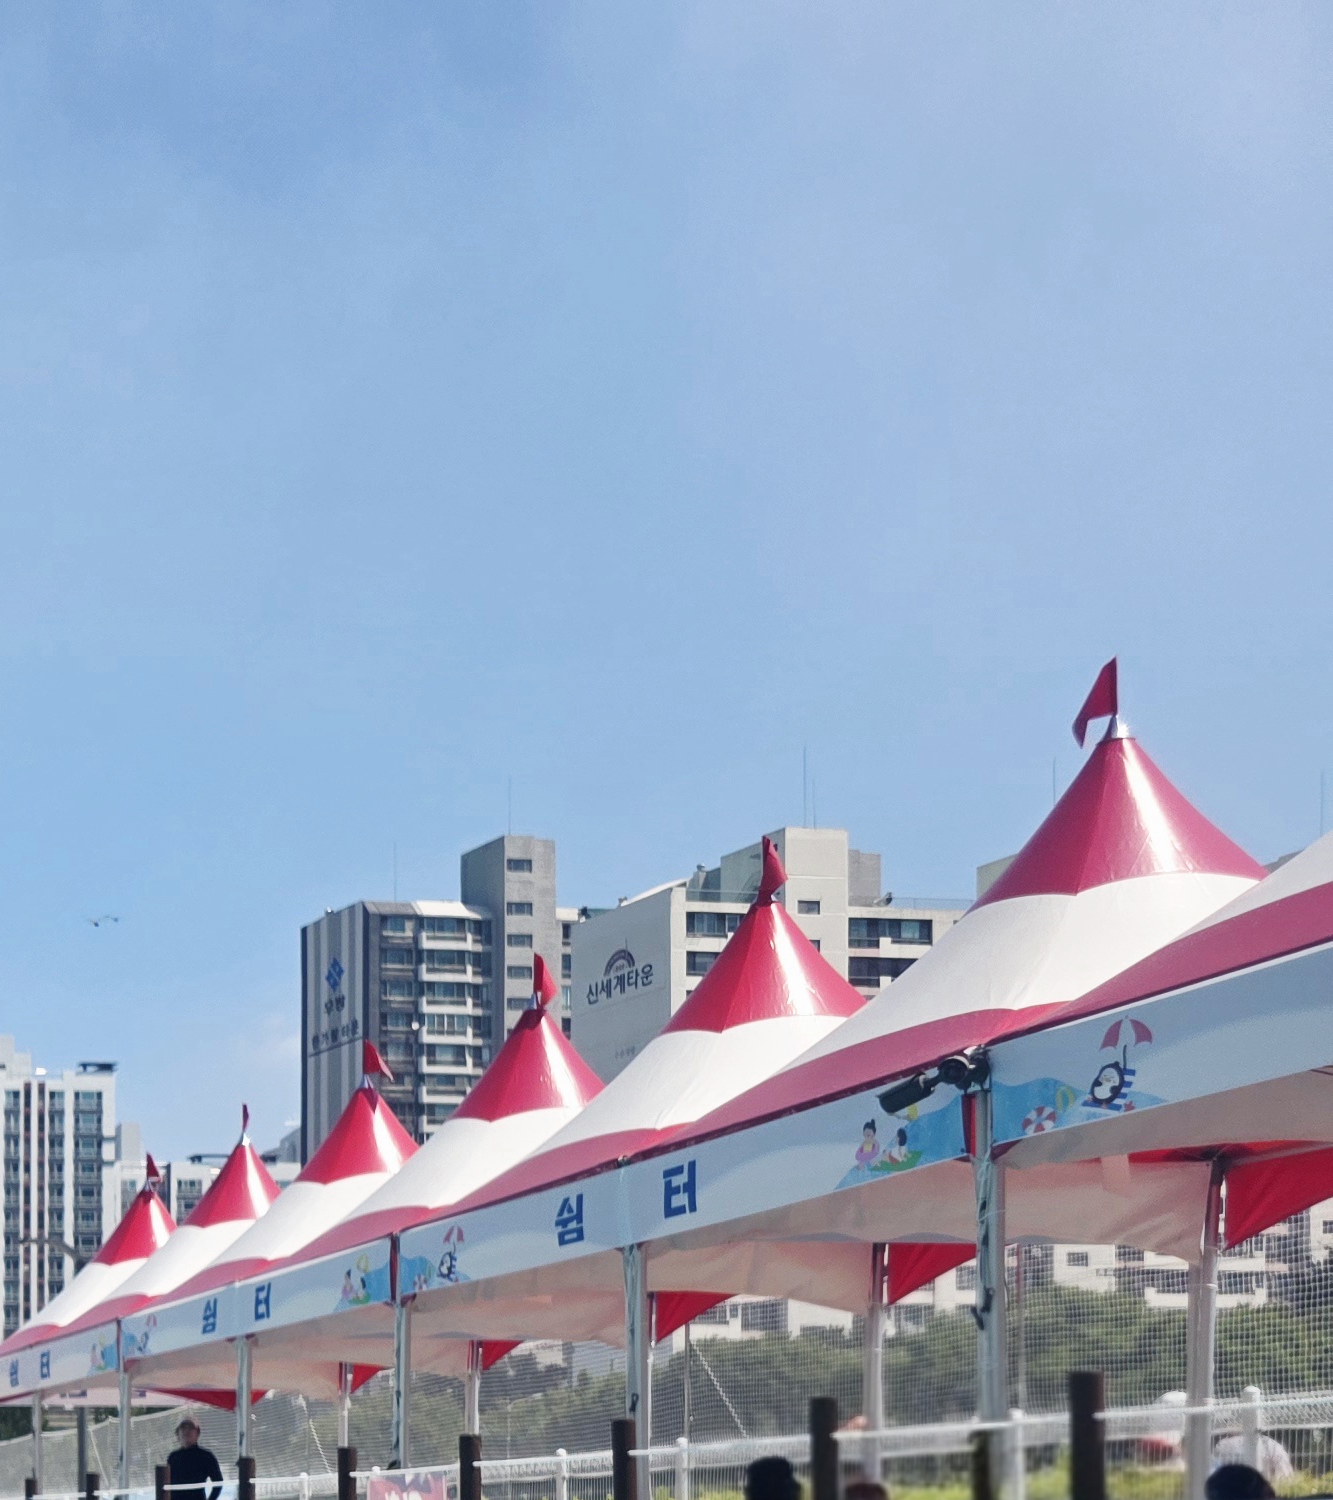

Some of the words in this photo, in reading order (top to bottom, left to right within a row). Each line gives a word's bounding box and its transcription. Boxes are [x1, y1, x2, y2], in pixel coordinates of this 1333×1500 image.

[586, 963, 653, 1005] 신세계타운
[555, 1193, 584, 1247] 쉼
[663, 1159, 697, 1219] 터
[202, 1298, 218, 1334] 쉼
[254, 1282, 271, 1321] 터
